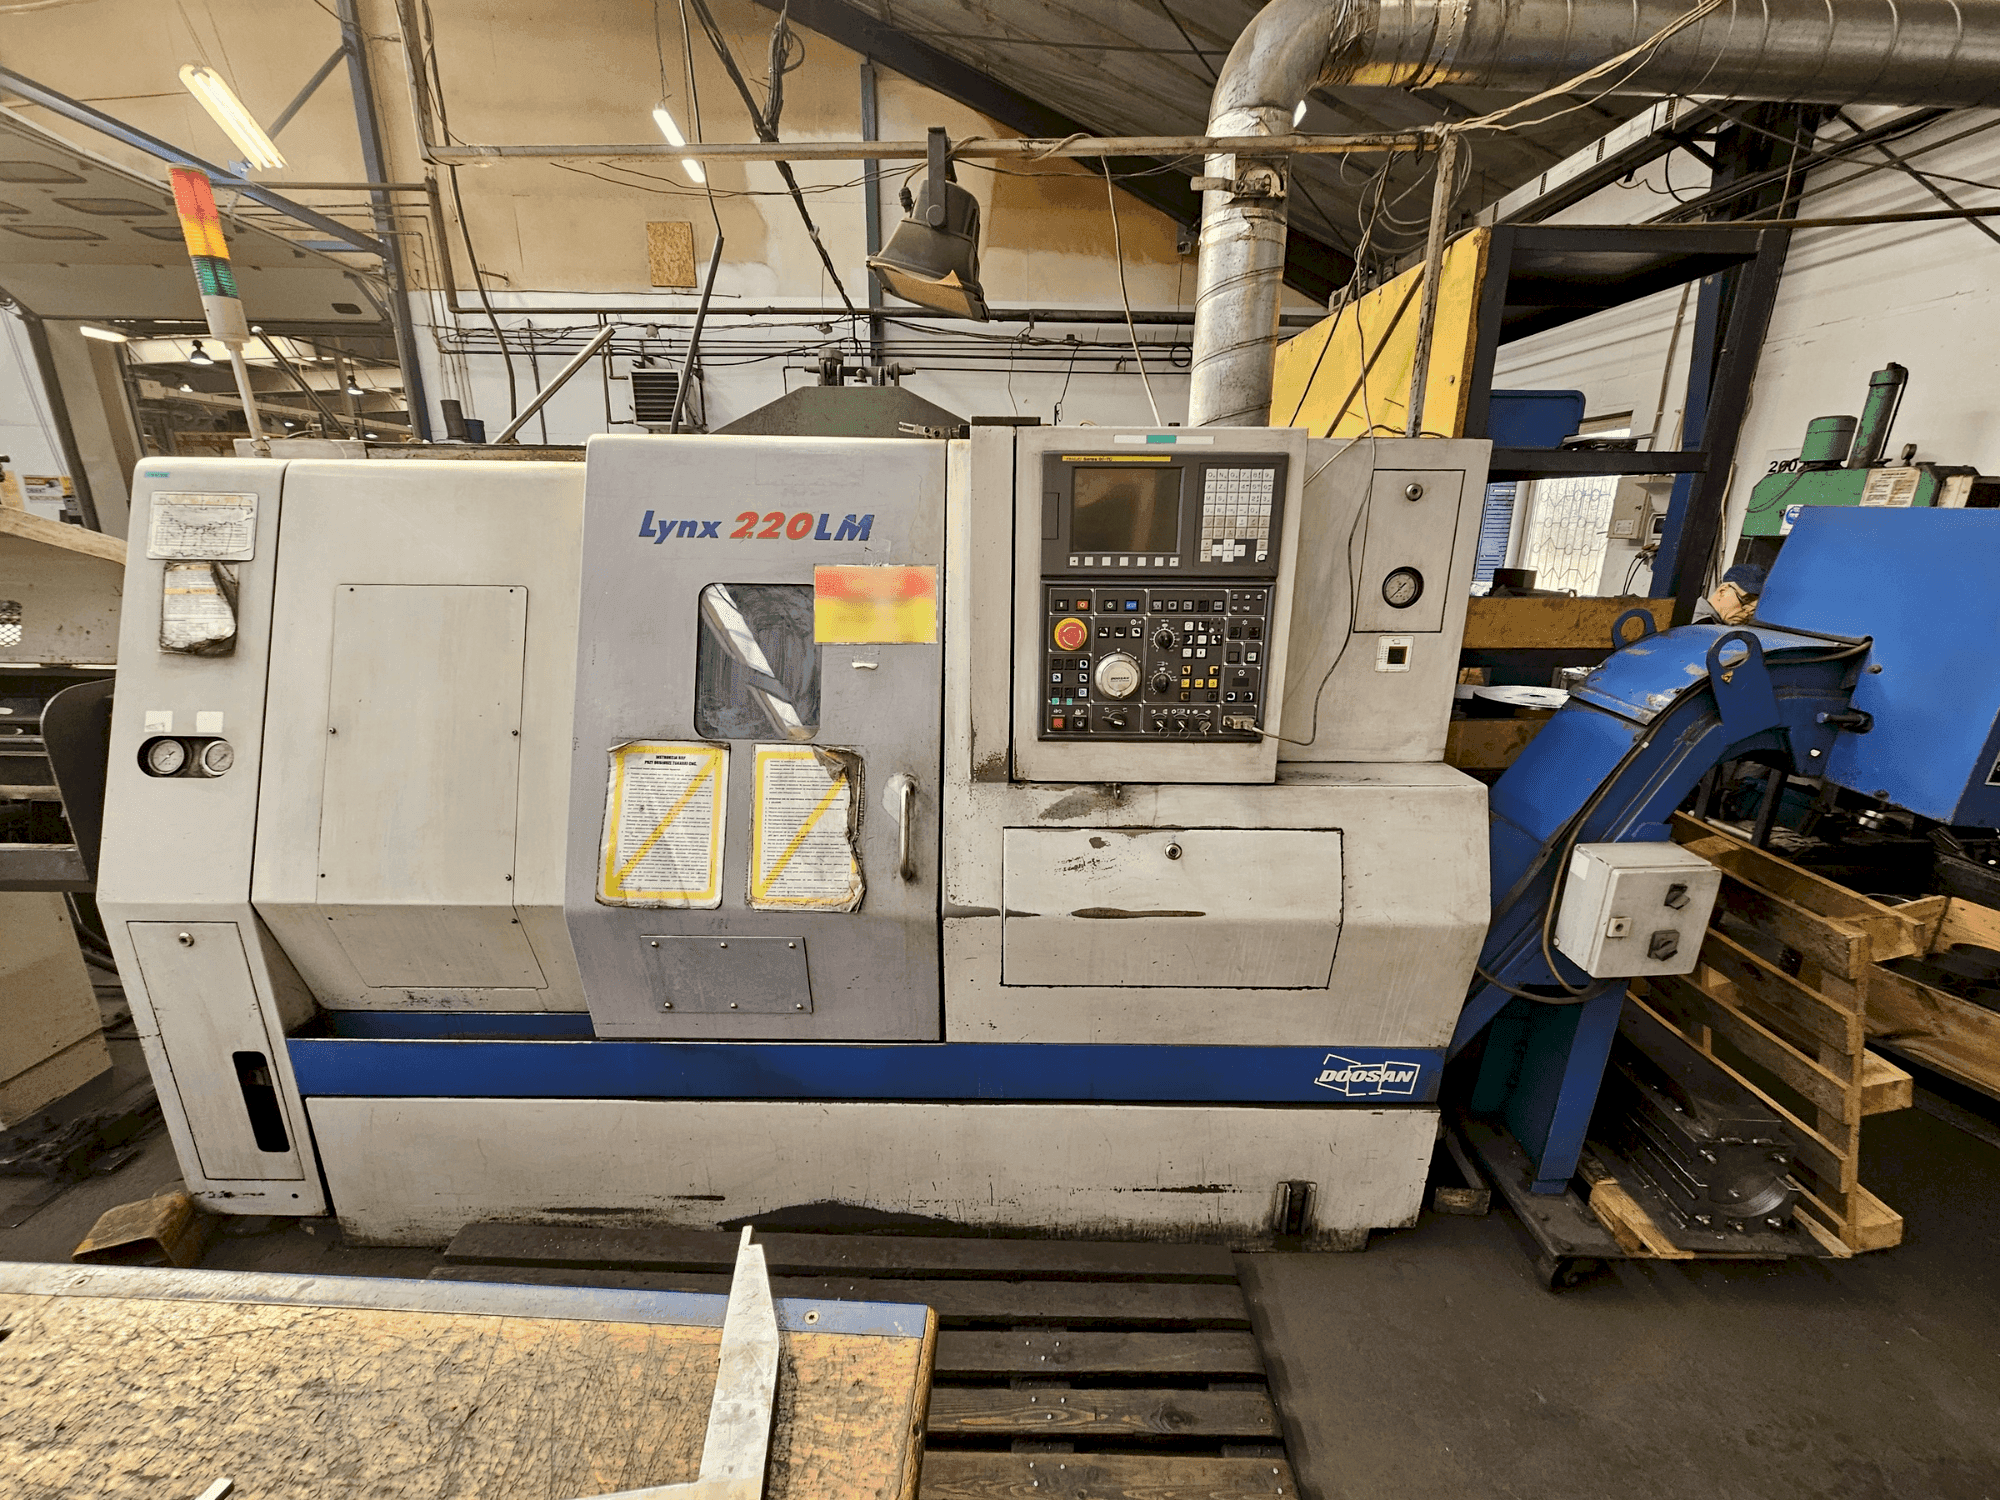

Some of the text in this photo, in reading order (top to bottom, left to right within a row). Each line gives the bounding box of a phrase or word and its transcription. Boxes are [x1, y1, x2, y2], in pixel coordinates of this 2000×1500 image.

[638, 510, 875, 544] Lynx 220LM
[1318, 1069, 1415, 1083] DOOSAN
